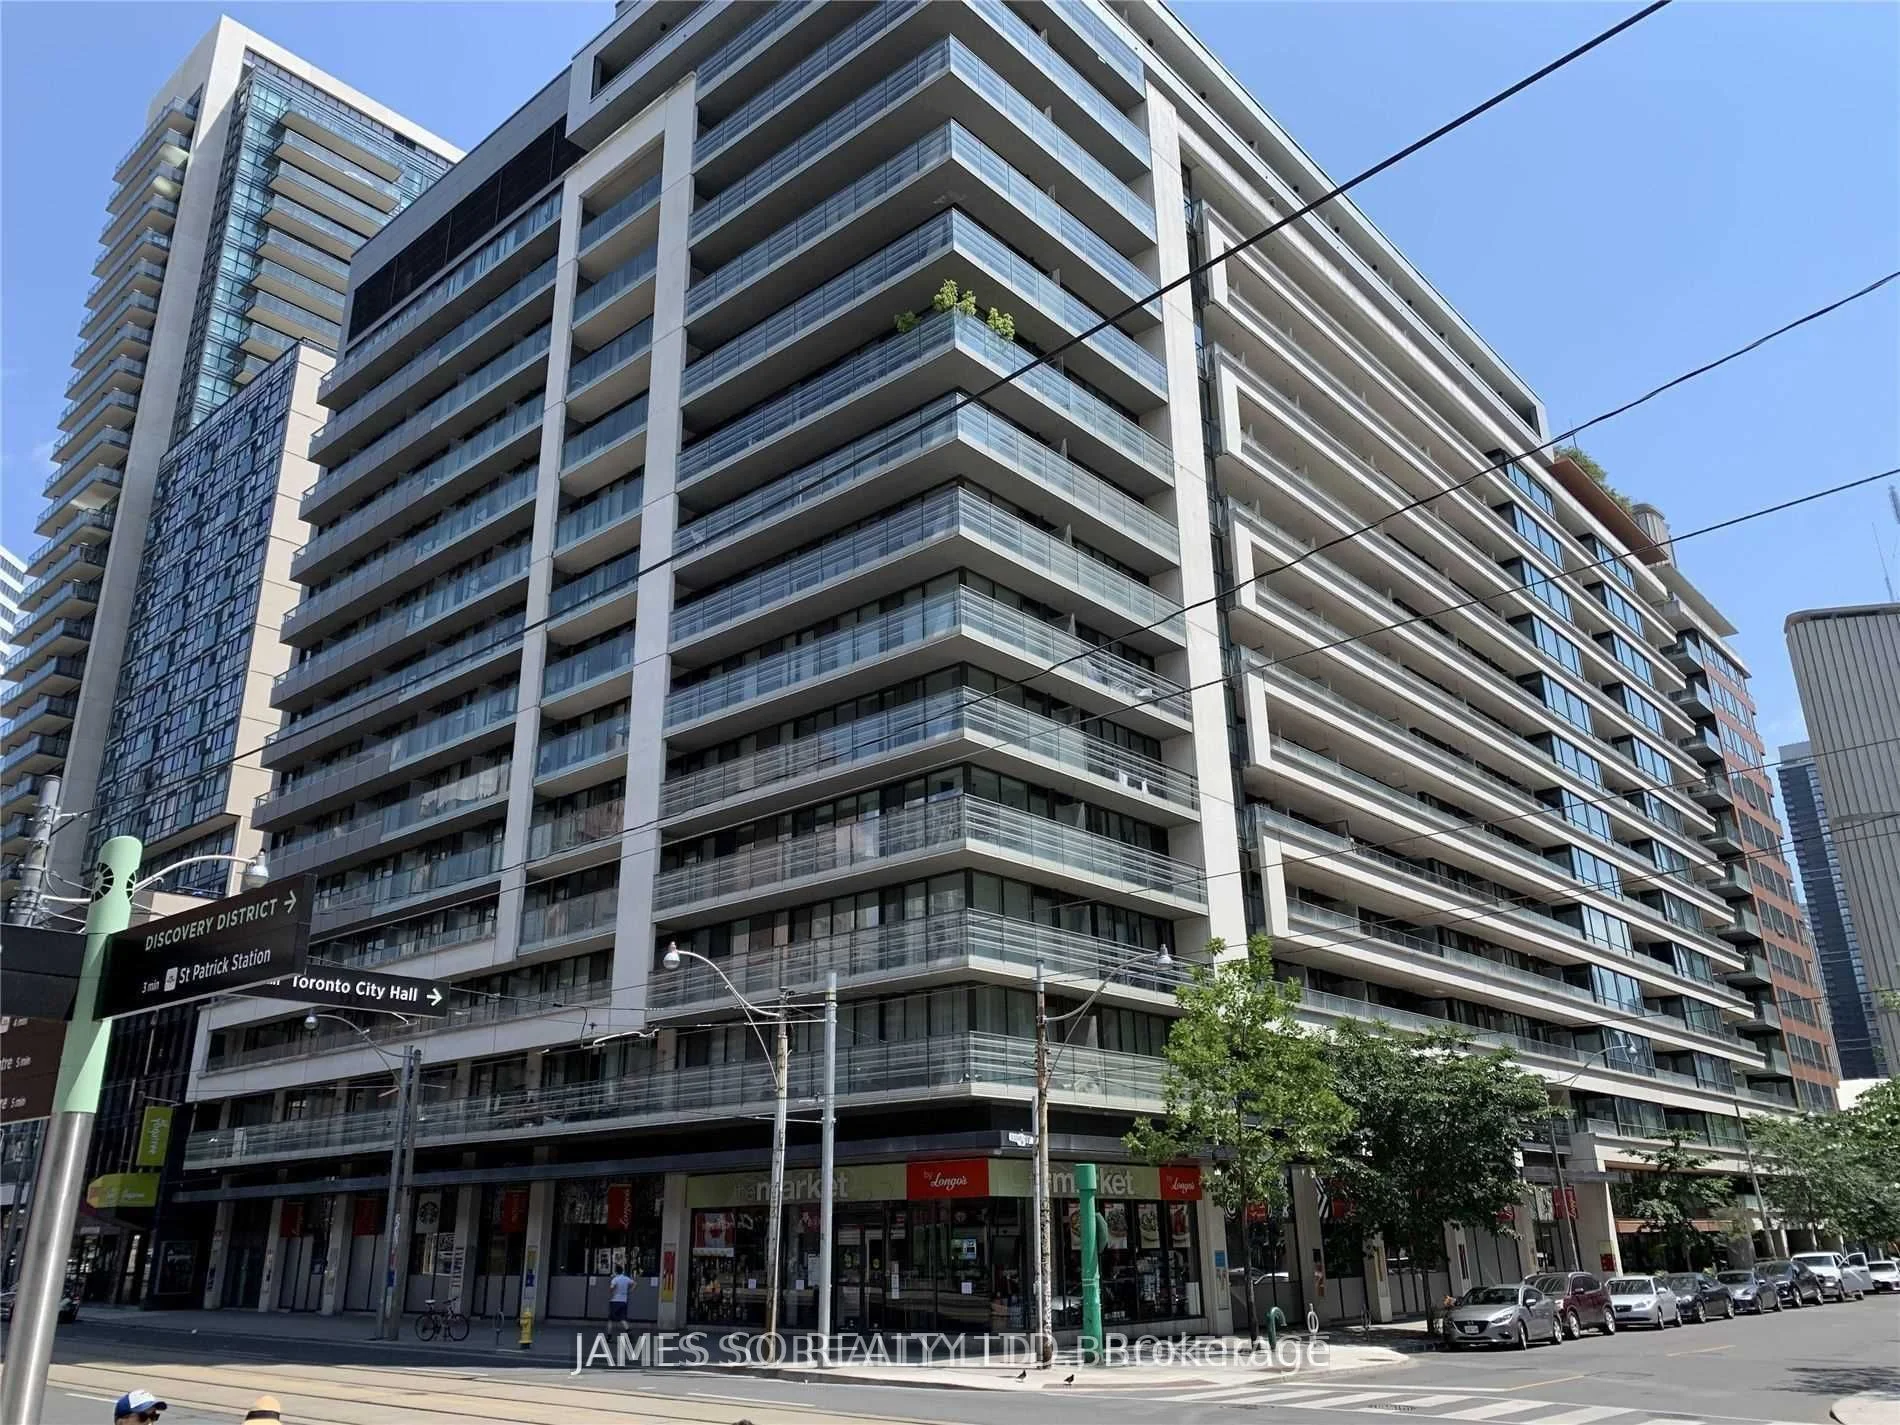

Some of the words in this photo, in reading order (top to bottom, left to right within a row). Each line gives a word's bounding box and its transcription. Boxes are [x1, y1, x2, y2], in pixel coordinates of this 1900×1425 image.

[144, 916, 214, 951] DISCOVERY
[217, 899, 278, 930] DISTRICT
[179, 967, 191, 984] St
[192, 956, 229, 981] Patrick
[231, 948, 271, 971] Station
[147, 978, 160, 992] min
[355, 981, 385, 1000] City
[390, 985, 418, 1002] Hall
[1053, 1168, 1135, 1195] mket
